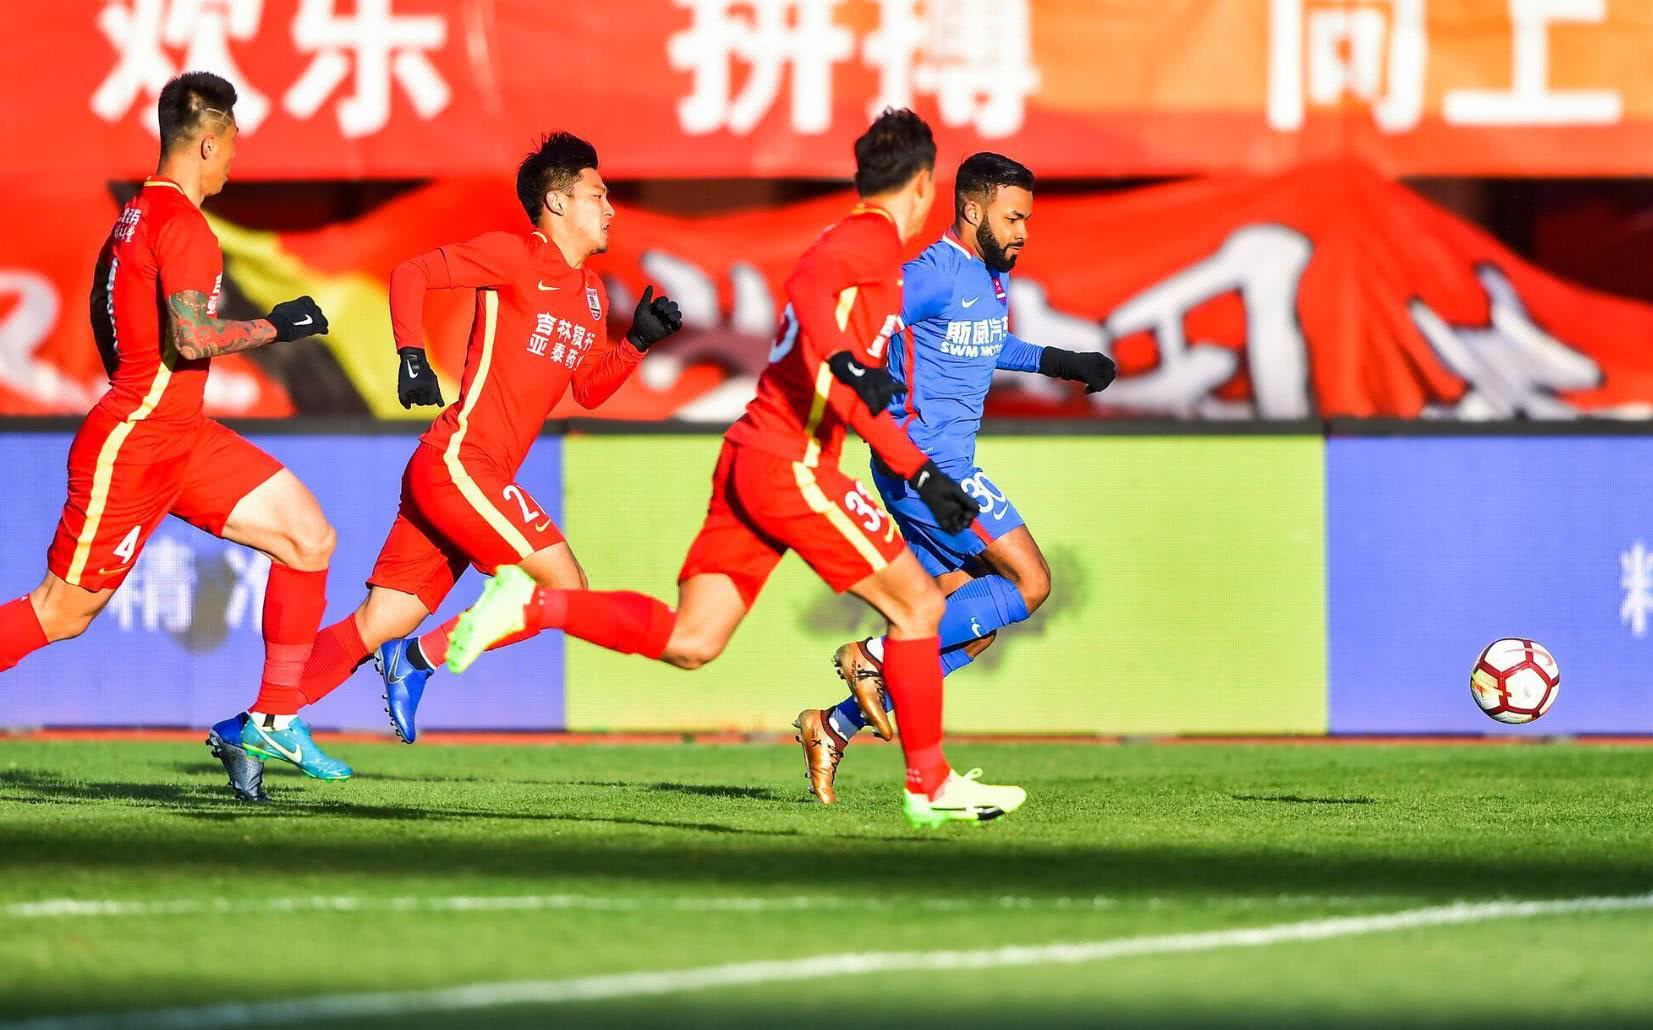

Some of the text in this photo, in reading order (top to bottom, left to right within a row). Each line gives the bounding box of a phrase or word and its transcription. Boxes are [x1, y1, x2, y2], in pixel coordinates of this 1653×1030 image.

[526, 333, 585, 371] 亚泰药
[940, 342, 978, 357] SWM
[960, 471, 1007, 514] 30
[112, 525, 142, 564] 4
